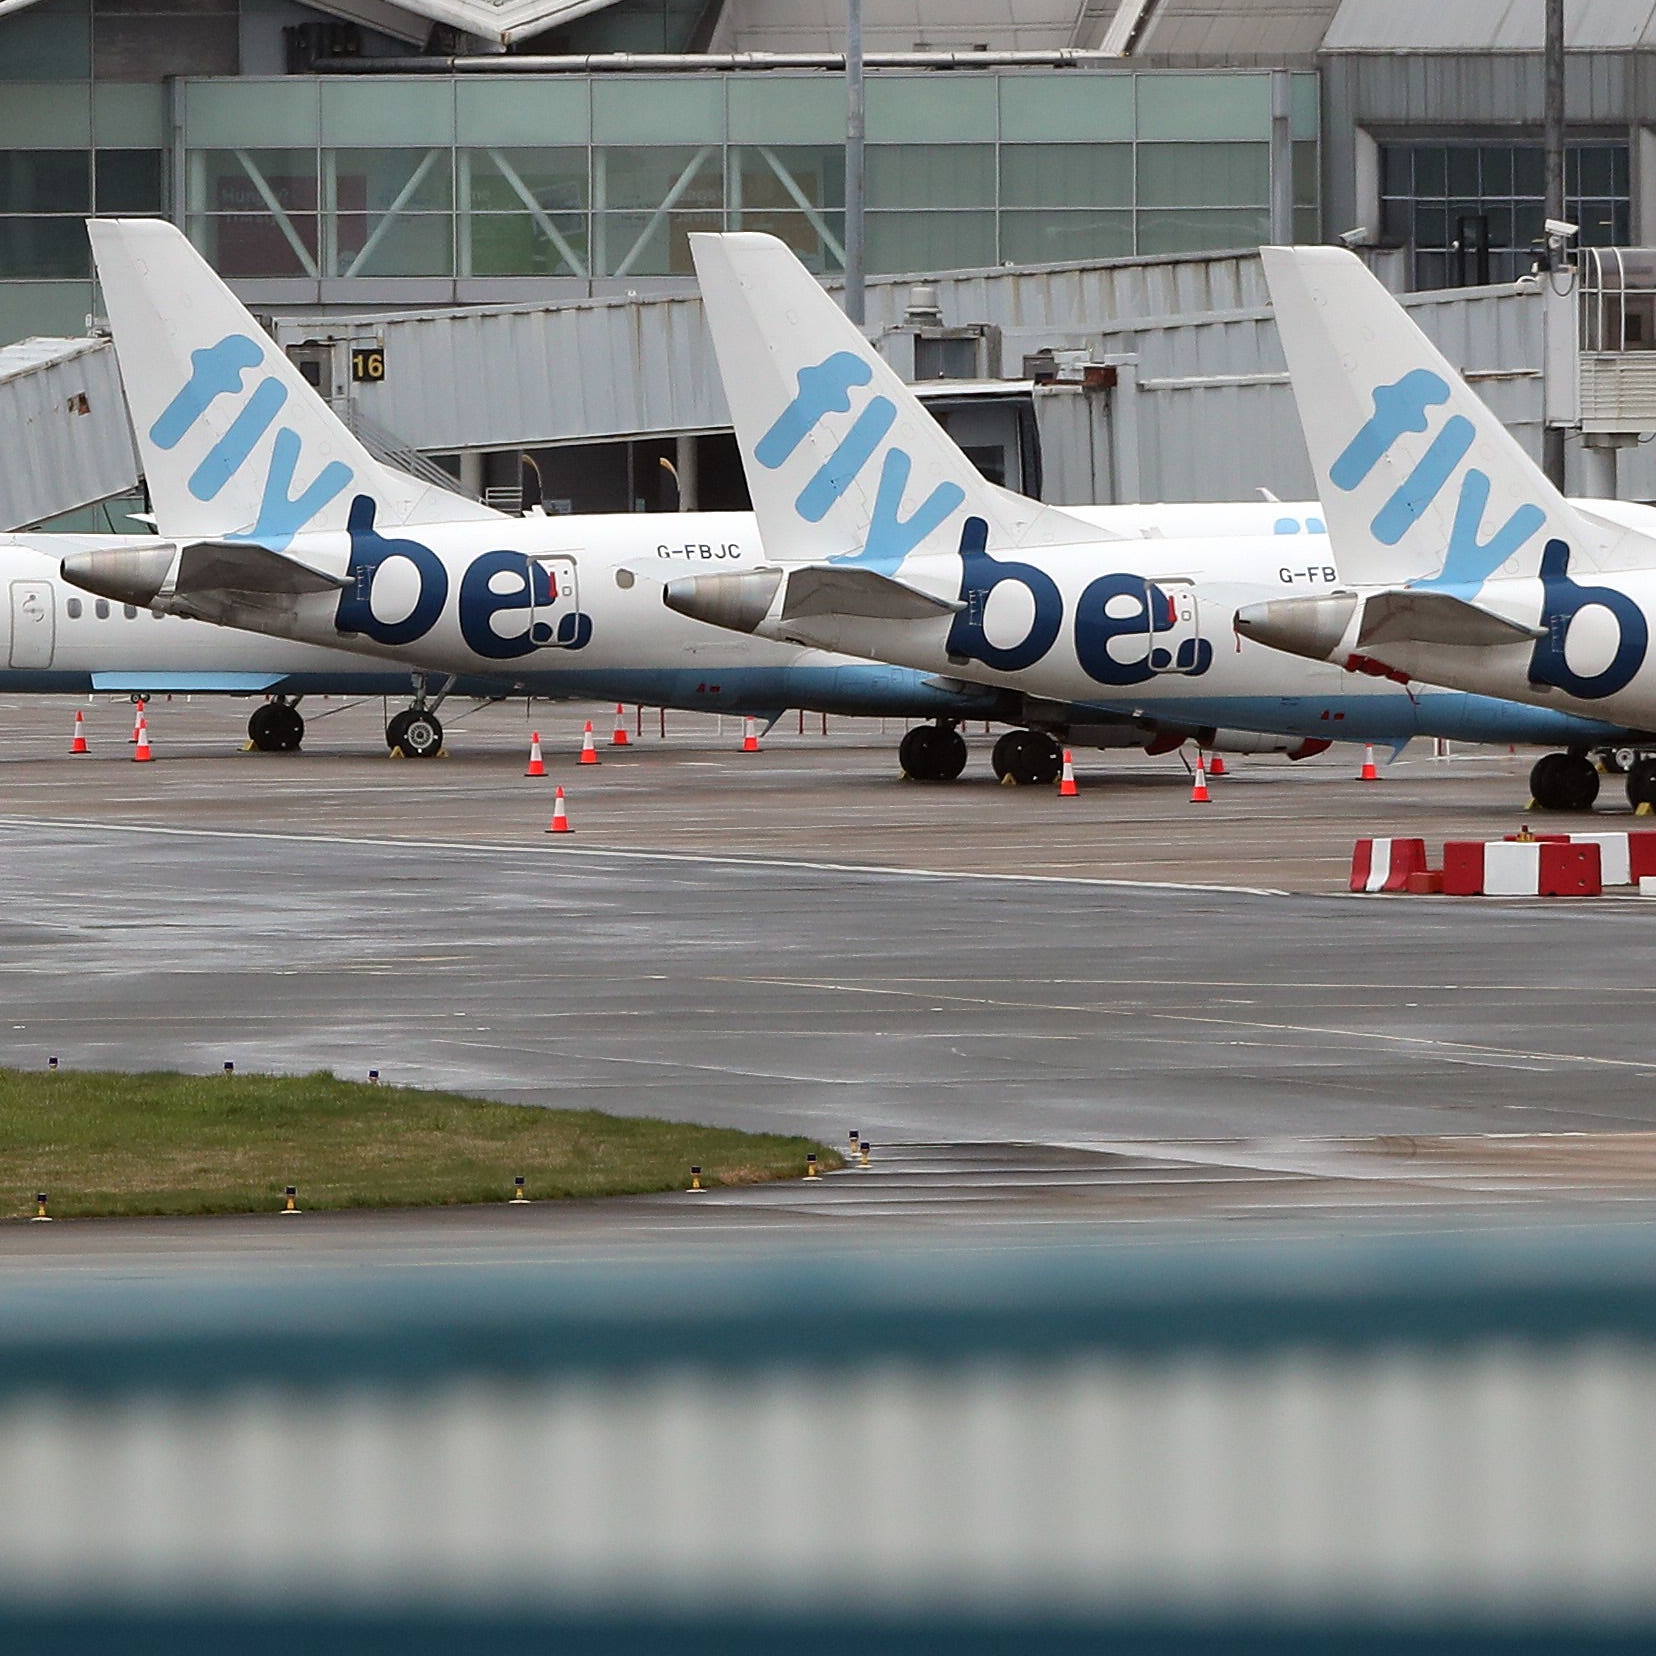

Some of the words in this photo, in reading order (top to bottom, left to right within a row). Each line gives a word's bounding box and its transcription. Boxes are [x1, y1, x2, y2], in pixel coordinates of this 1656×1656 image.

[353, 354, 383, 377] 16
[149, 333, 355, 553] fly
[754, 350, 966, 578] fly
[1329, 368, 1547, 603] fly
[656, 543, 742, 560] G-FBJC
[1279, 566, 1337, 583] G-FB
